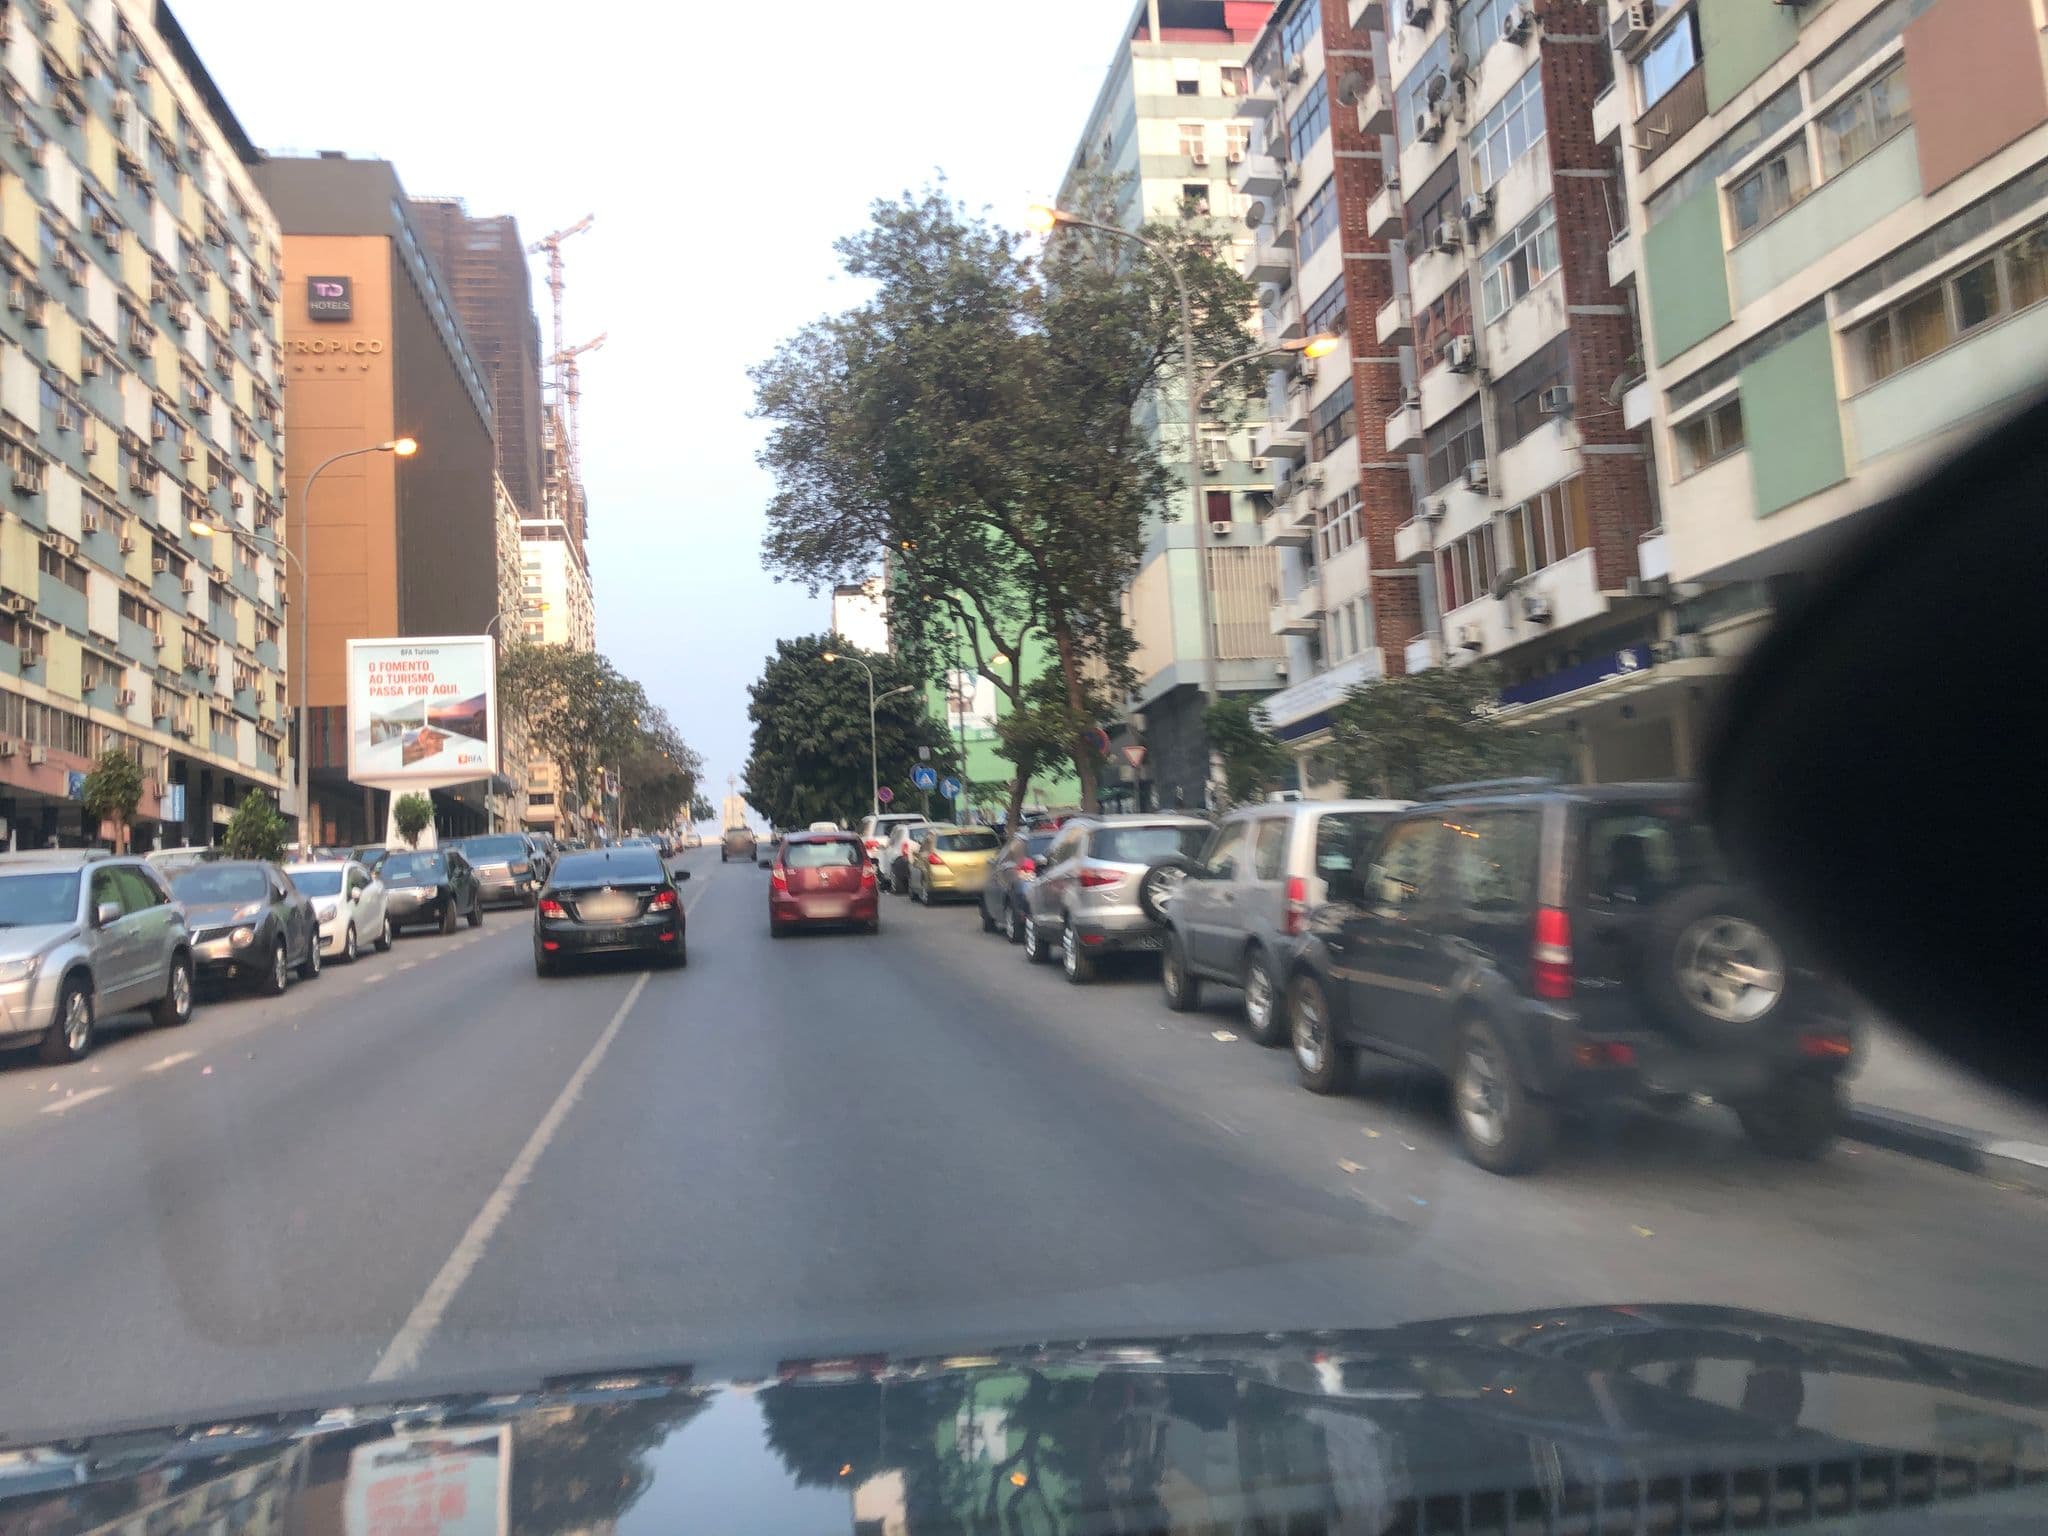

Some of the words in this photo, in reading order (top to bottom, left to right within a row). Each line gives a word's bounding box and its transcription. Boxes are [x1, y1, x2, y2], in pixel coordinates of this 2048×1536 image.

[313, 283, 343, 296] TD
[311, 302, 350, 310] HOTELS
[415, 648, 440, 656] Turismo
[369, 662, 376, 672] O
[380, 661, 429, 672] FOMENTO
[369, 674, 383, 684] AO
[387, 673, 434, 684] TURISMO
[369, 686, 404, 696] PASSA
[408, 685, 429, 696] POR
